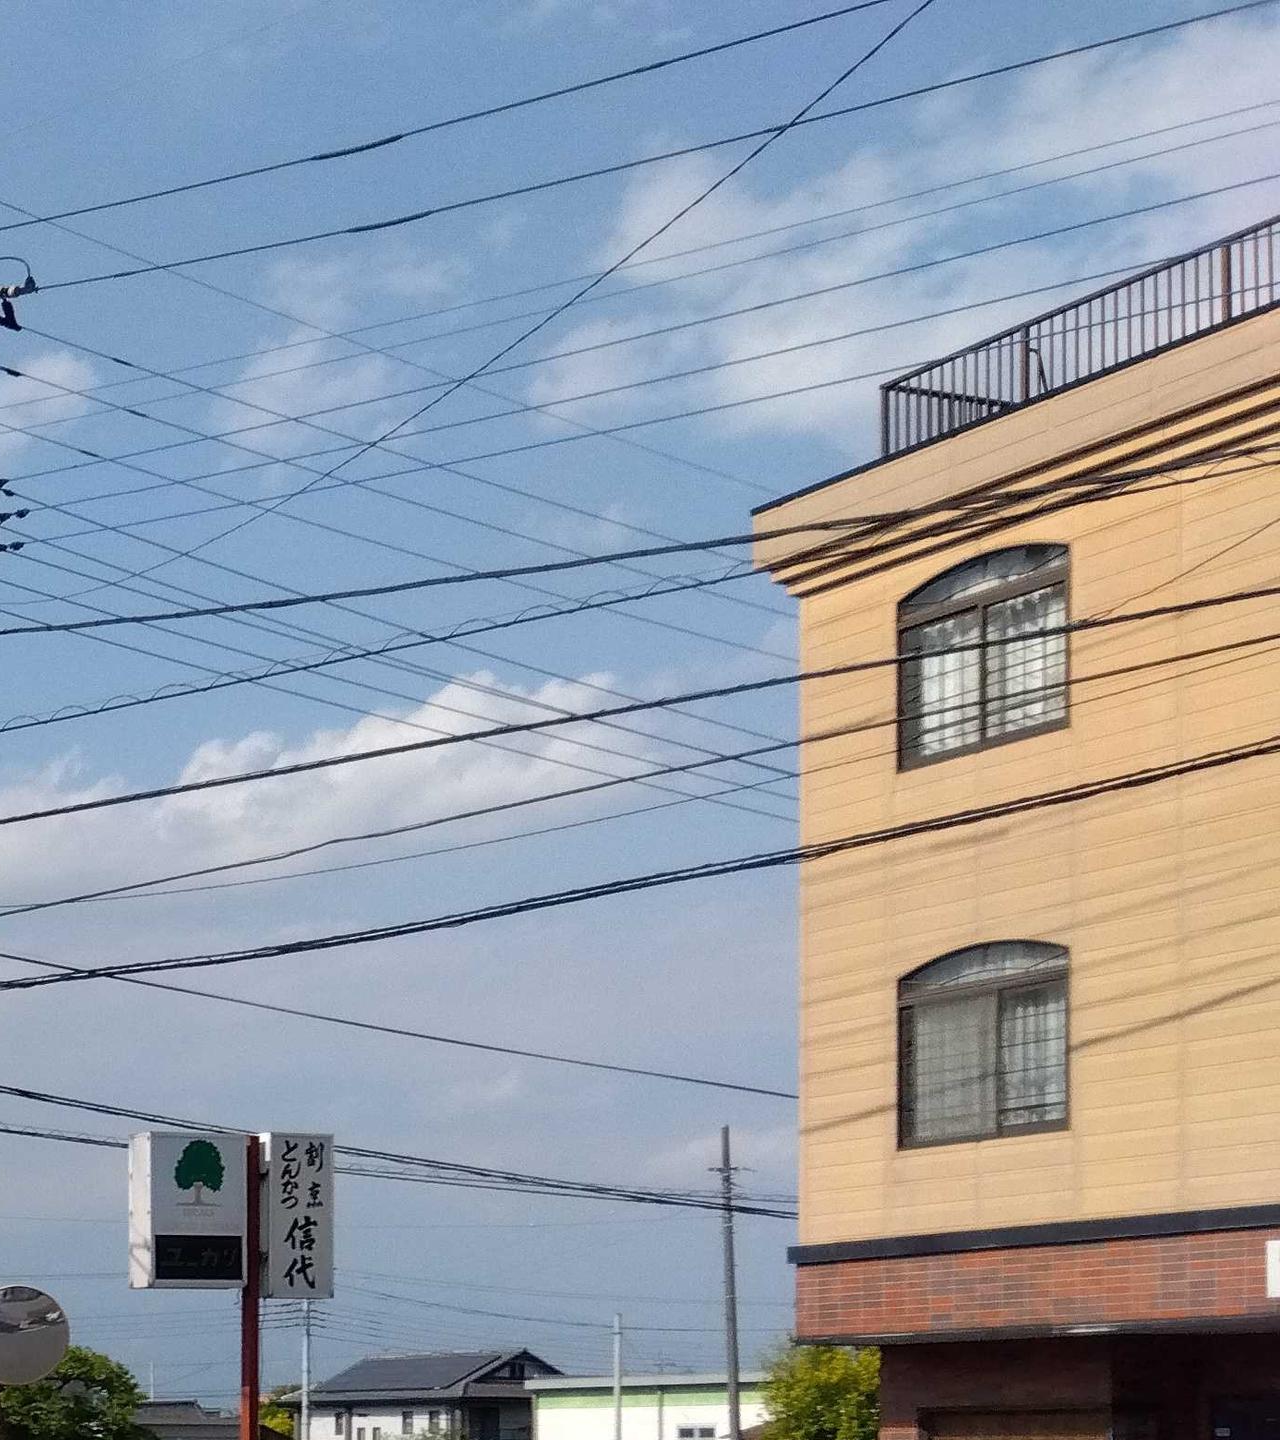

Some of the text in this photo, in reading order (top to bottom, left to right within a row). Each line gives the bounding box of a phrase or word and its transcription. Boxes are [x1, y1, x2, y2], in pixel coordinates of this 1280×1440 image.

[280, 1140, 302, 1210] とんかつ
[283, 1215, 319, 1290] 信代
